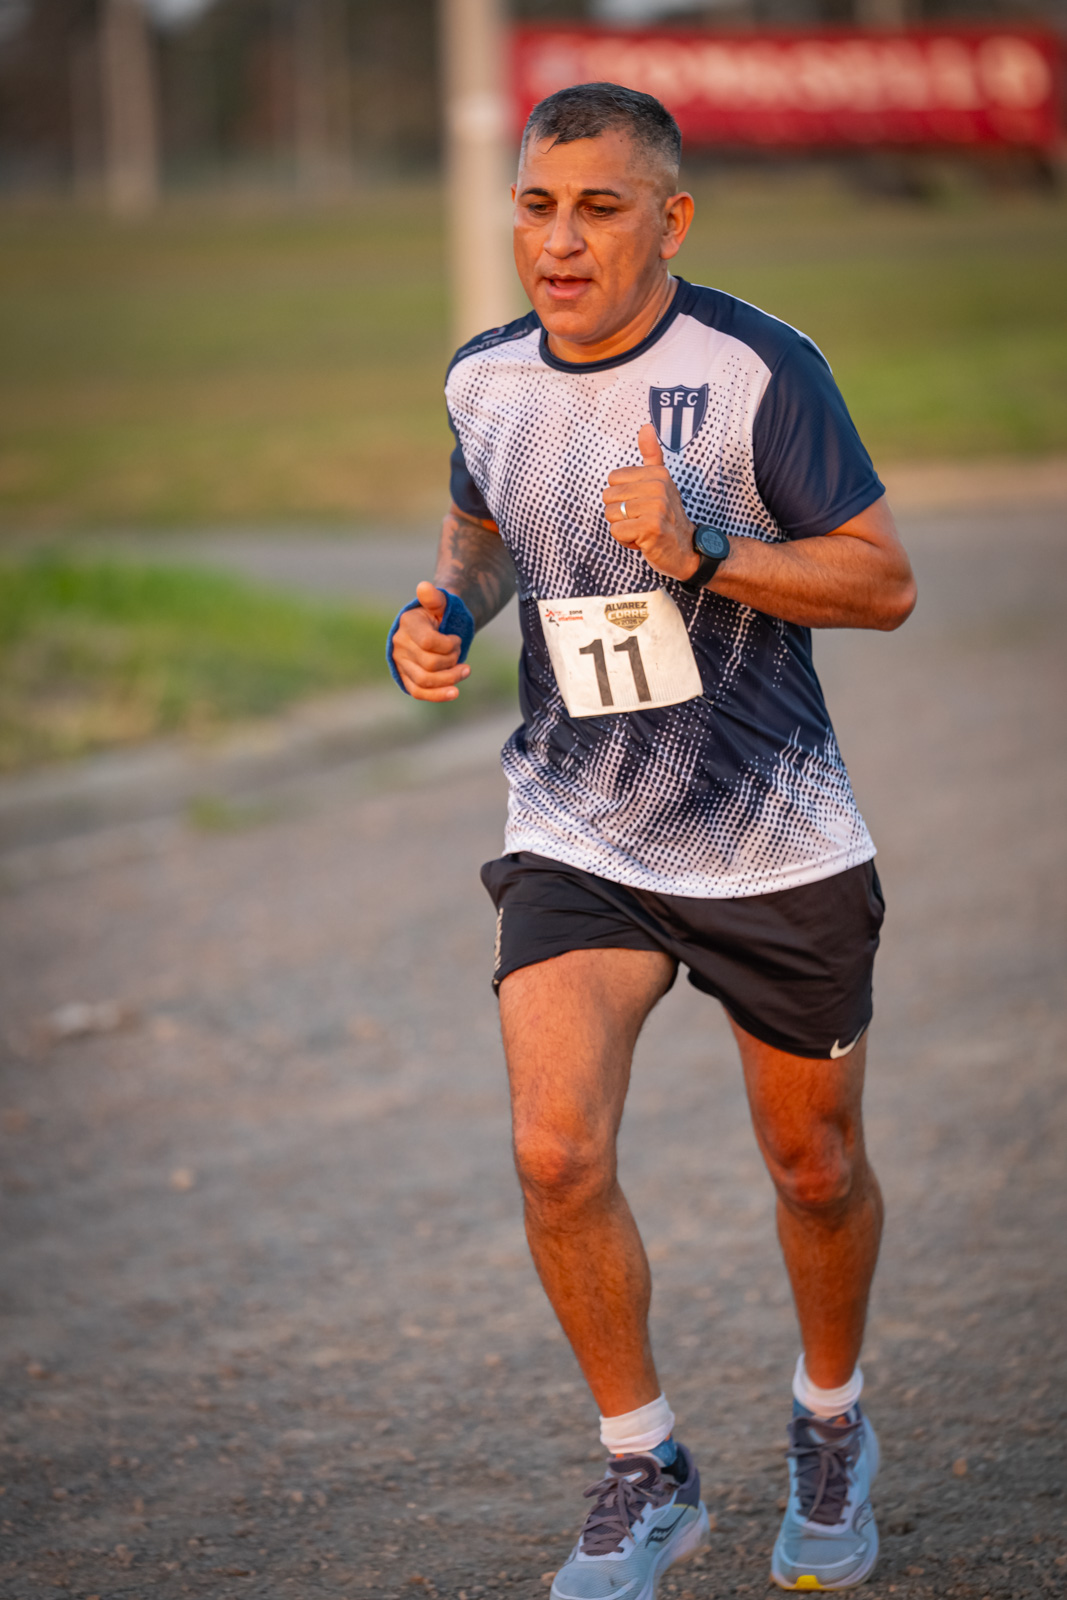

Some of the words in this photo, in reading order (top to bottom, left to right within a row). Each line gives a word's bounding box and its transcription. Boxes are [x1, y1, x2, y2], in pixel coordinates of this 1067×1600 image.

[659, 392, 699, 406] SFC
[605, 602, 647, 613] ALVAREZ
[608, 609, 647, 620] CORRE
[579, 636, 651, 706] 11
